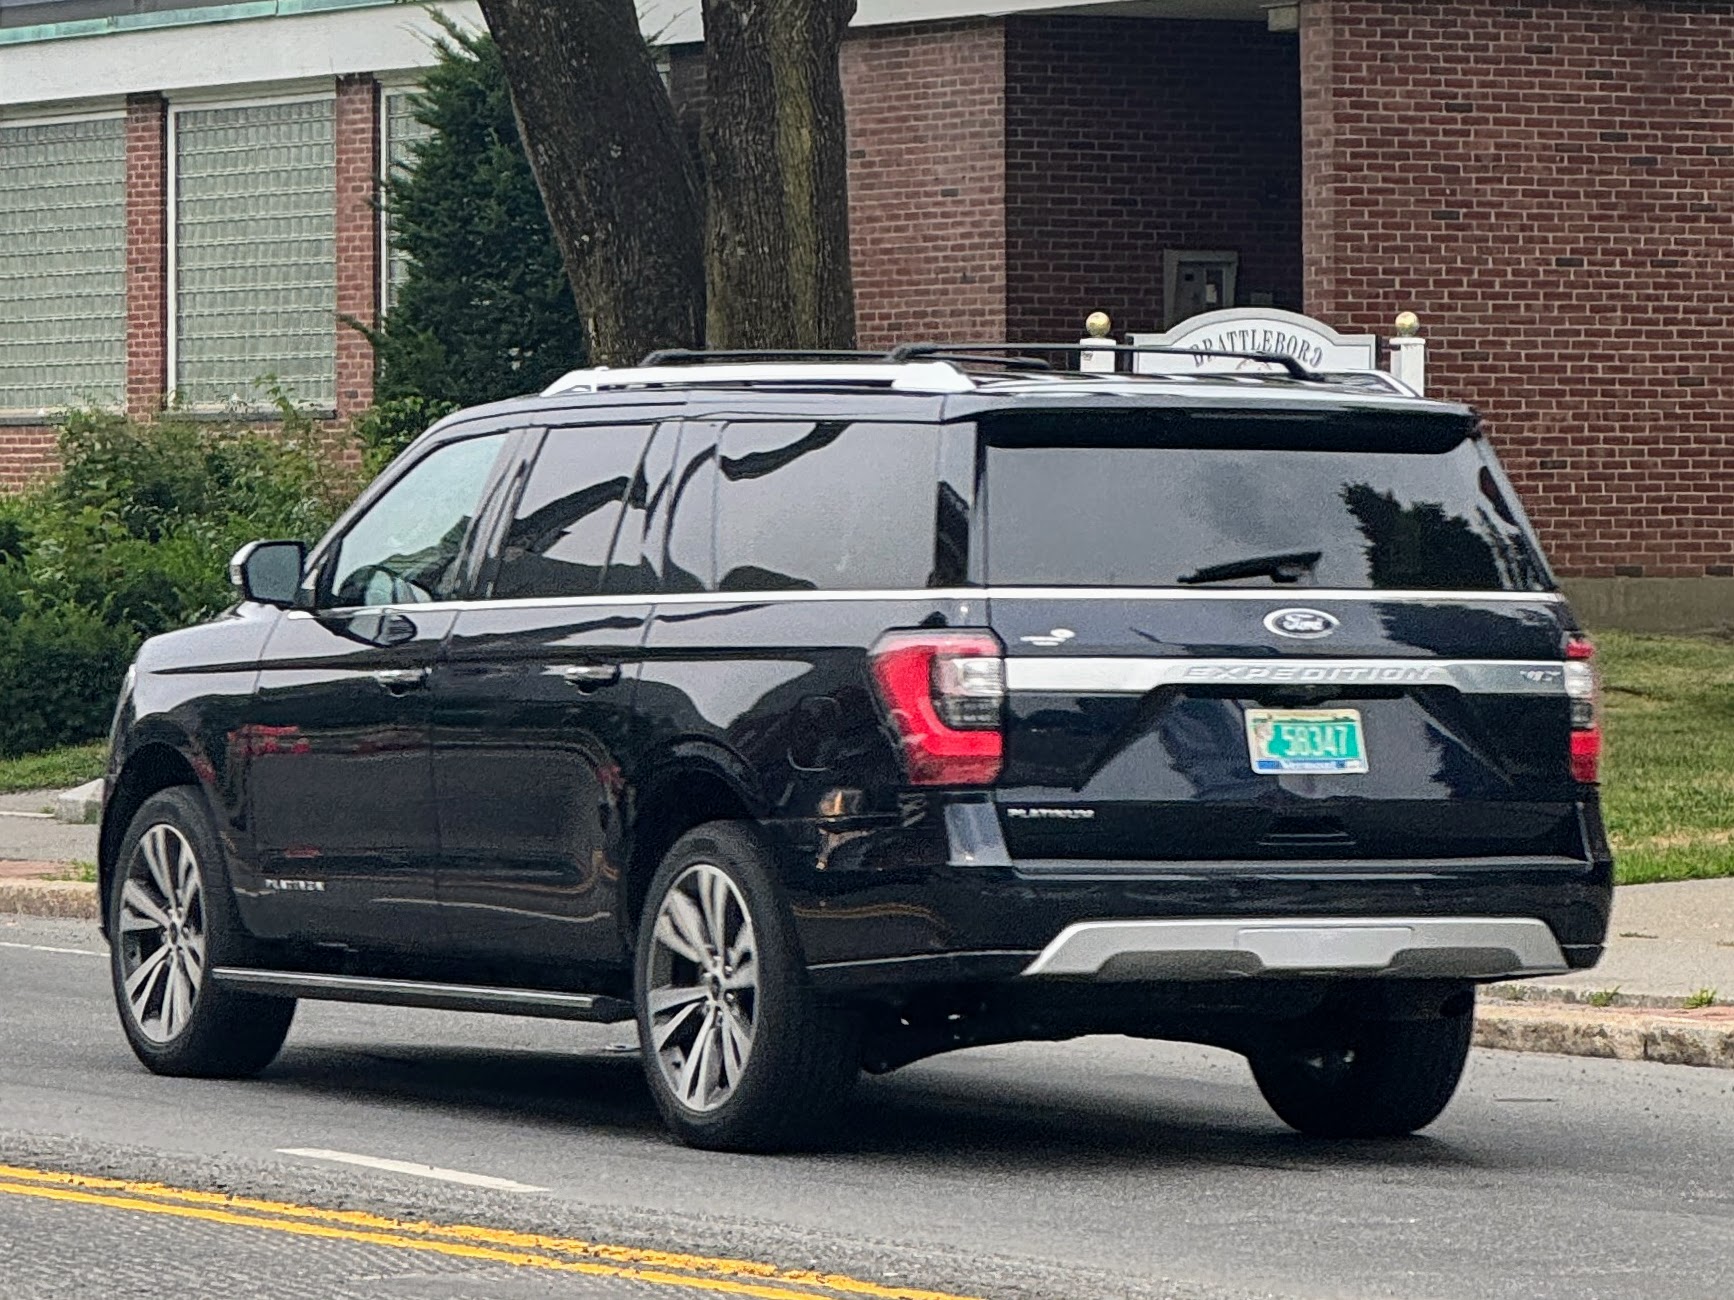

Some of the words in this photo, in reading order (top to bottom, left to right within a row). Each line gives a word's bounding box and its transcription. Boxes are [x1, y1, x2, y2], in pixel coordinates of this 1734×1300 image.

[1190, 328, 1324, 368] BRATTLEBORO
[1182, 665, 1438, 681] EXPEDITION
[1280, 724, 1349, 757] 58347
